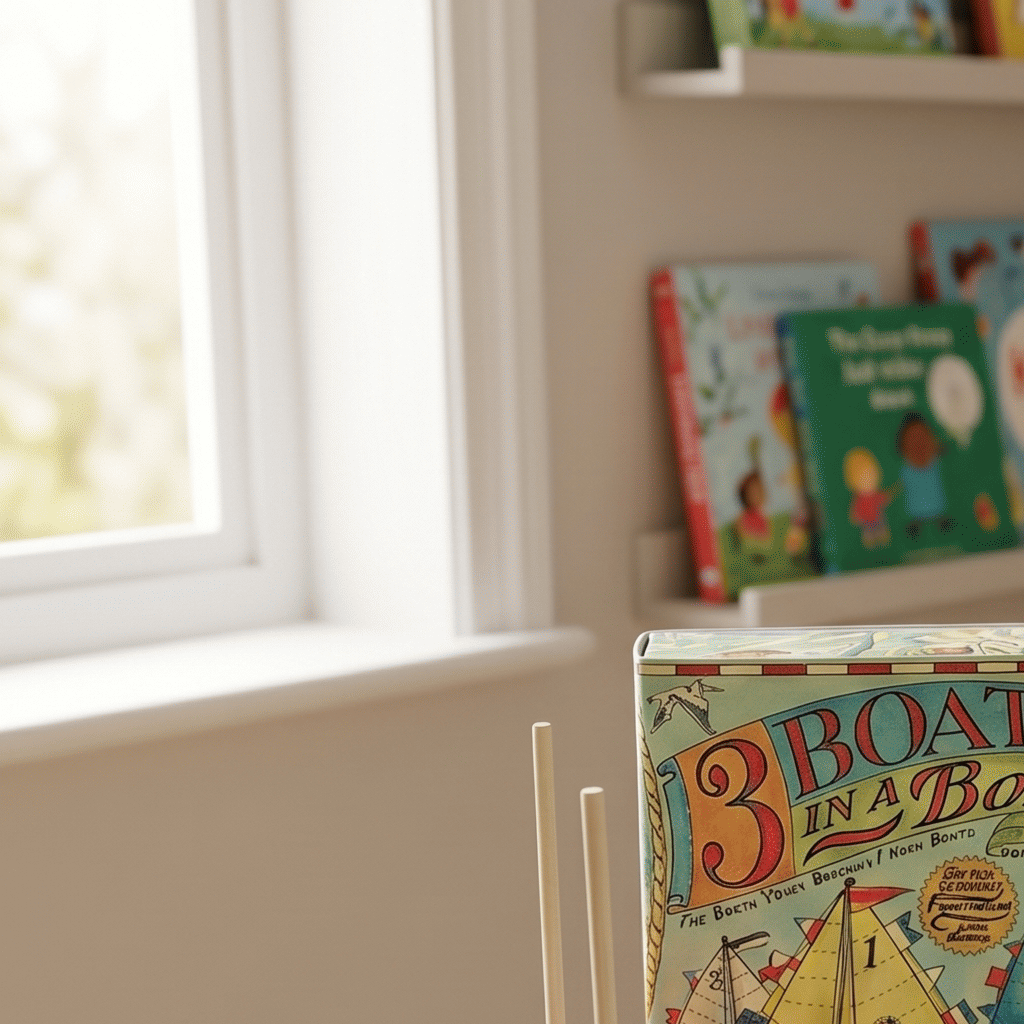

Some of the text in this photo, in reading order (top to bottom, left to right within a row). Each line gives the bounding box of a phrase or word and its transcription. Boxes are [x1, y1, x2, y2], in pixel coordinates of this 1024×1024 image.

[695, 738, 785, 889] 3
[801, 788, 858, 838] IN
[866, 776, 900, 814] A
[863, 935, 877, 969] 1
